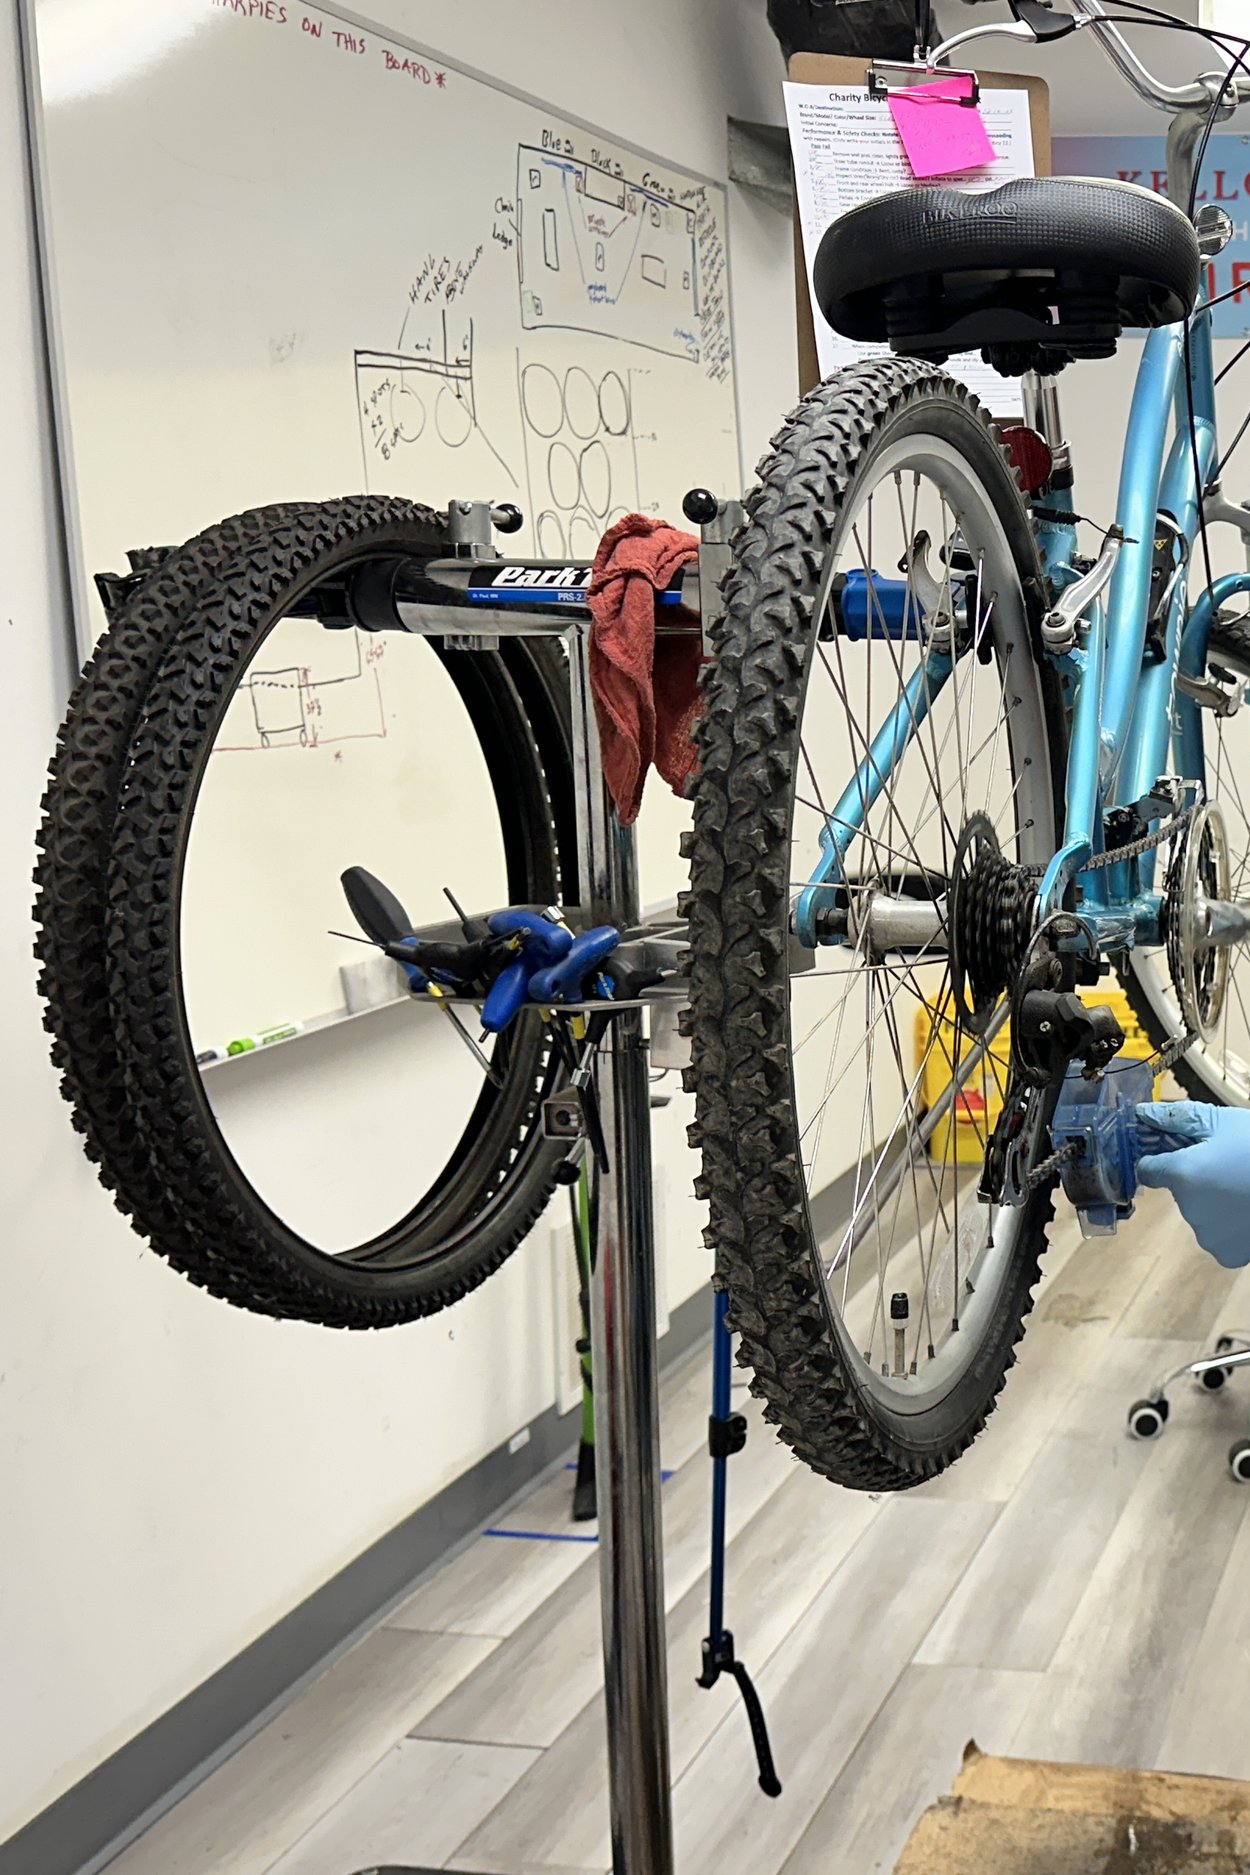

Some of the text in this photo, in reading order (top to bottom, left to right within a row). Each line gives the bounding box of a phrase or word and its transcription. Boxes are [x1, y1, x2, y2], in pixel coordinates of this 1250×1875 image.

[302, 17, 323, 38] ON
[332, 31, 366, 54] THIS
[382, 50, 431, 85] BOARD
[829, 93, 861, 103] Charity
